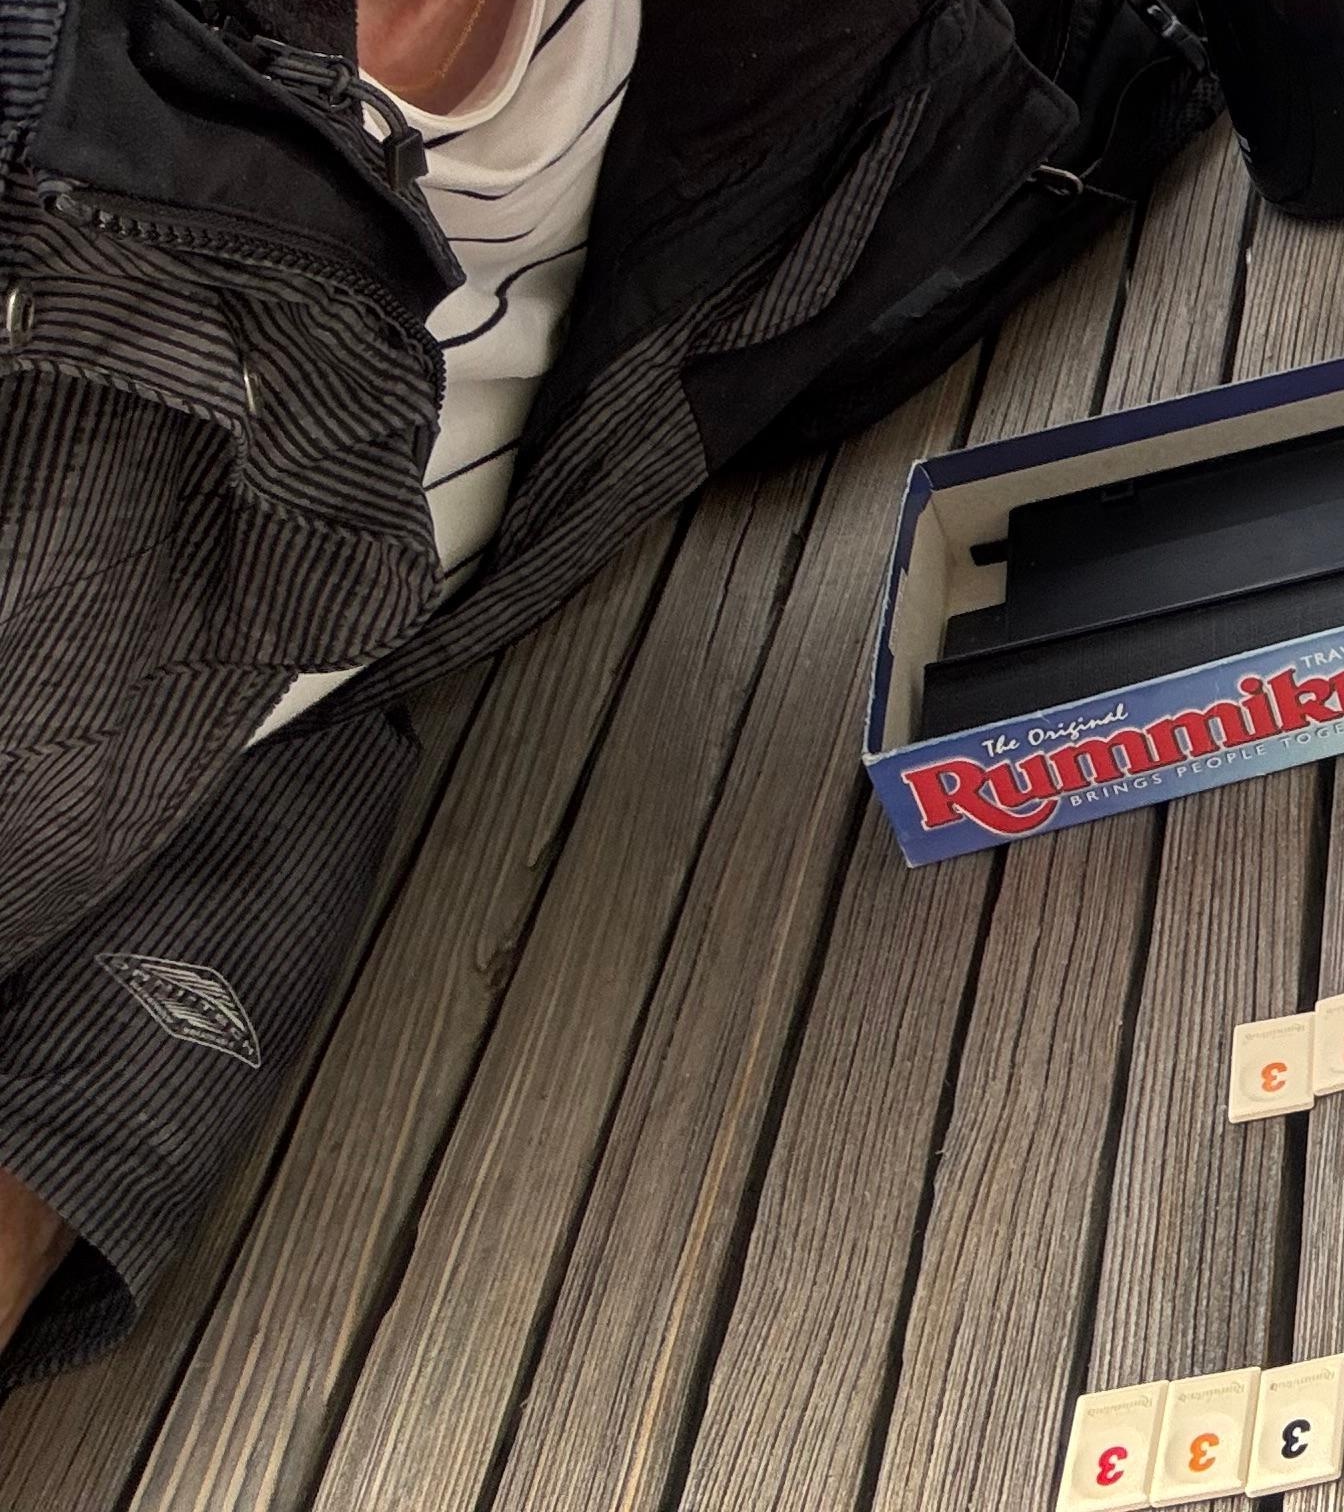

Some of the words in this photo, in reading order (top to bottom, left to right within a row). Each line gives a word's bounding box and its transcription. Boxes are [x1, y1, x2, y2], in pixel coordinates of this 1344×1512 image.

[982, 734, 1020, 757] The
[1028, 703, 1128, 746] Original
[1071, 774, 1162, 807] BRINGS
[1176, 743, 1267, 778] PEOPLE
[1261, 1062, 1287, 1092] 3
[1188, 1433, 1220, 1473] 3
[1281, 1419, 1311, 1459] 3
[1095, 1446, 1129, 1486] 3
